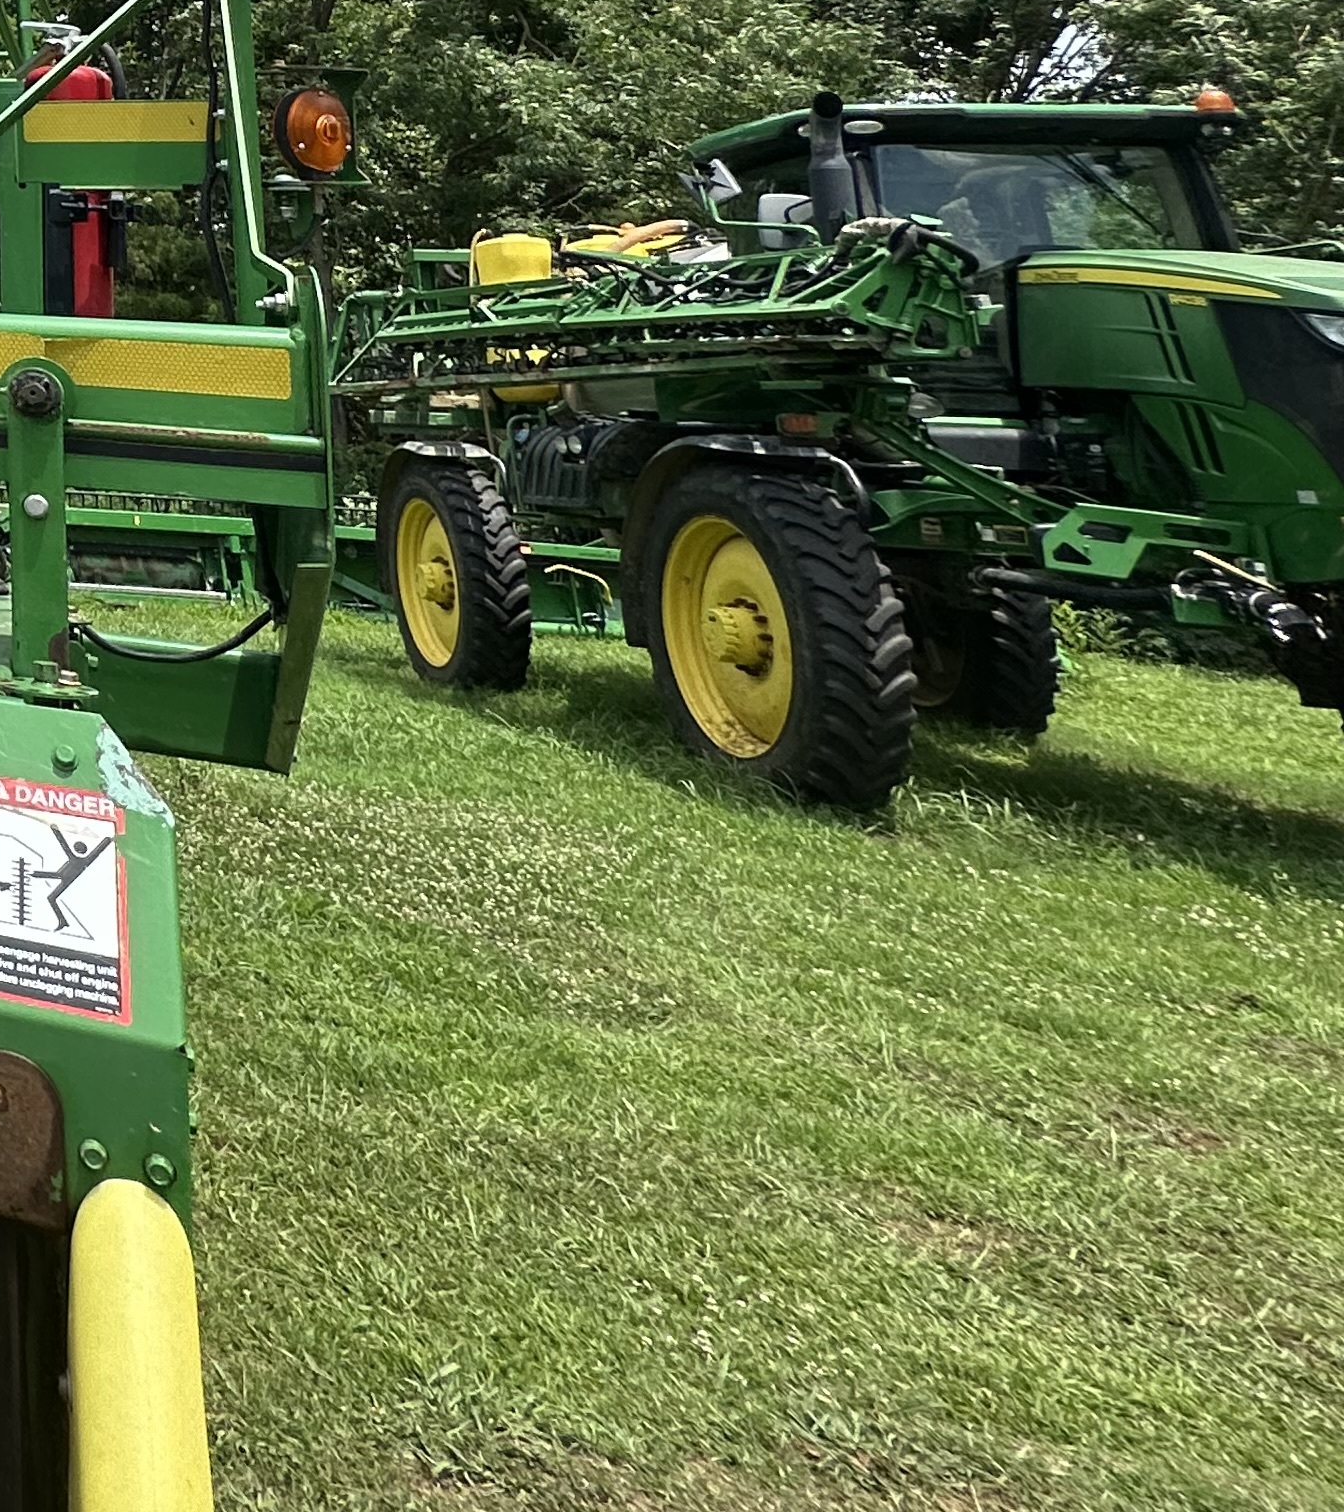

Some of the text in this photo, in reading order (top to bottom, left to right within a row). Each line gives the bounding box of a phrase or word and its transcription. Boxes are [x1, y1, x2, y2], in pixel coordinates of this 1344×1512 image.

[14, 785, 116, 818] DANGER
[16, 961, 37, 975] and
[38, 966, 63, 981] shut
[64, 971, 80, 984] off
[81, 975, 119, 992] engine
[42, 952, 96, 975] harvesting
[97, 965, 118, 978] unit
